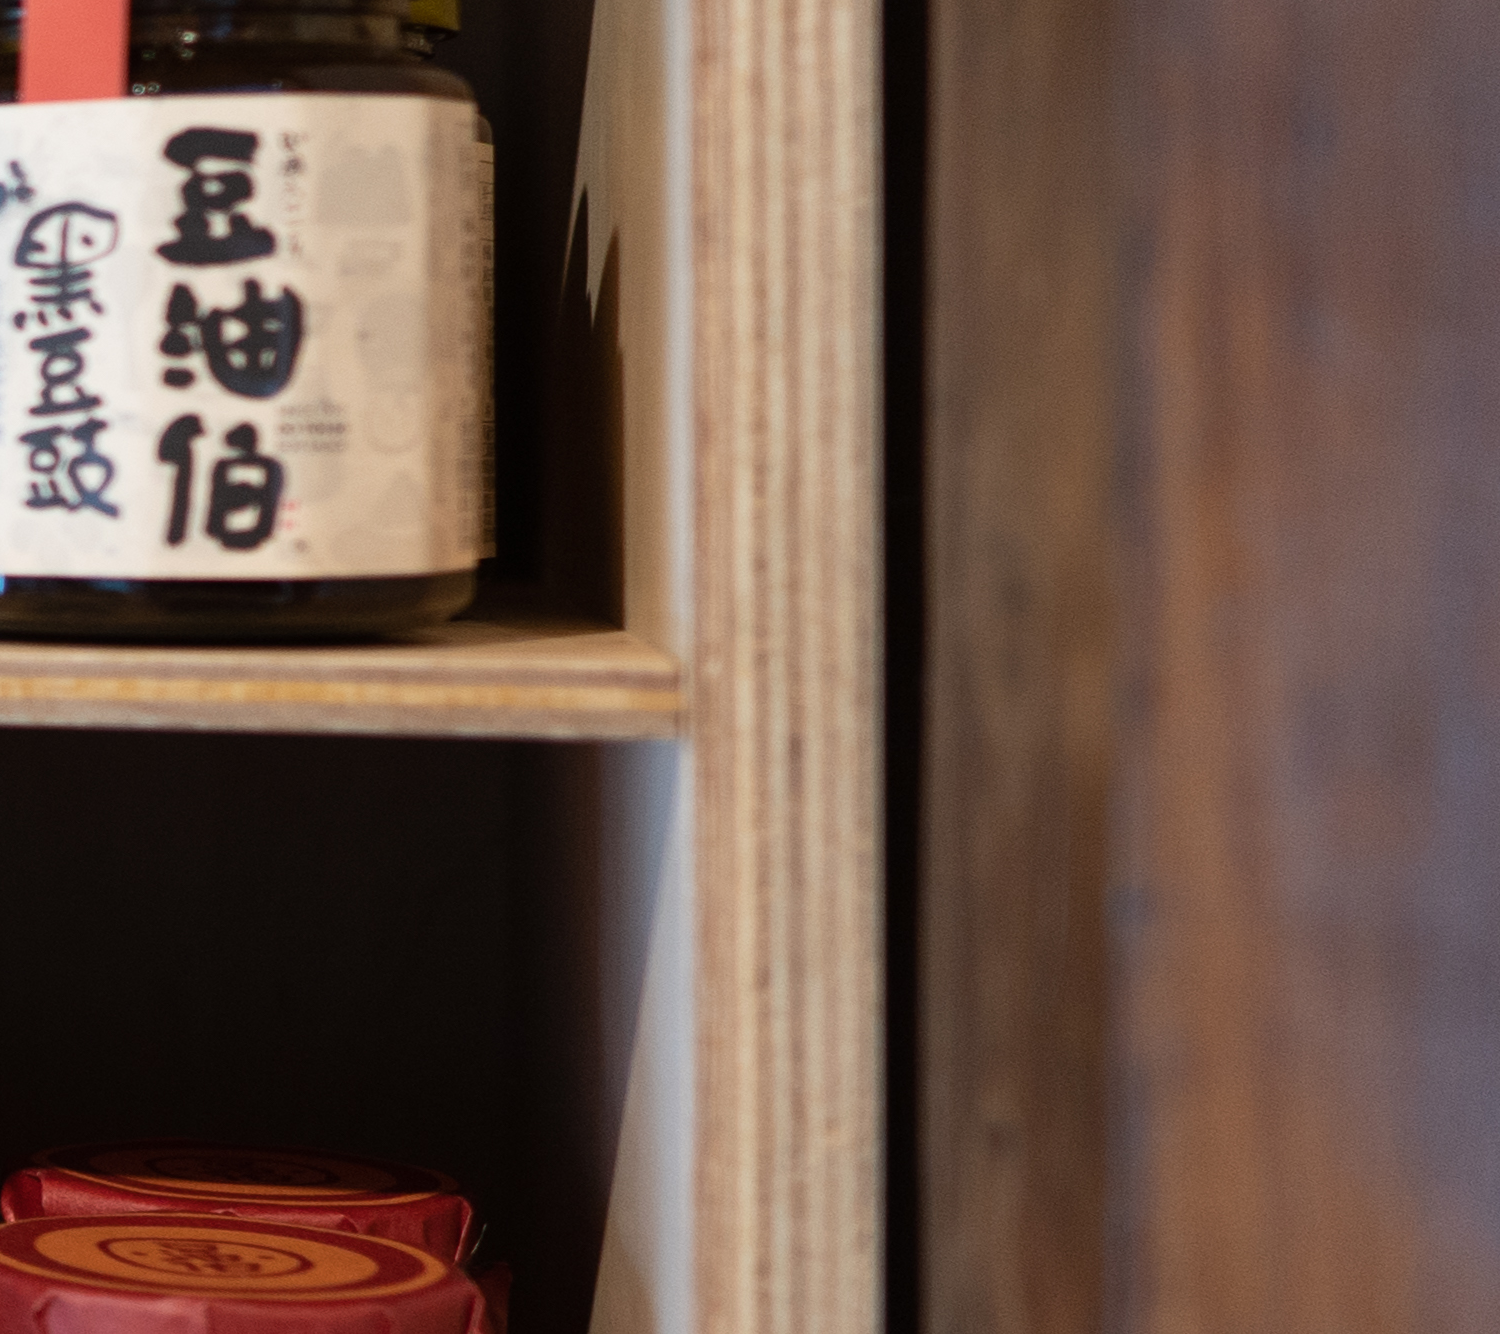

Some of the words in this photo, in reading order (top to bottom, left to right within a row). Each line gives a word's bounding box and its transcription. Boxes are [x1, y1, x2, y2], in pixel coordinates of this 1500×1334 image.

[13, 202, 121, 518] 黑豆豉
[155, 126, 306, 552] 豆油伯
